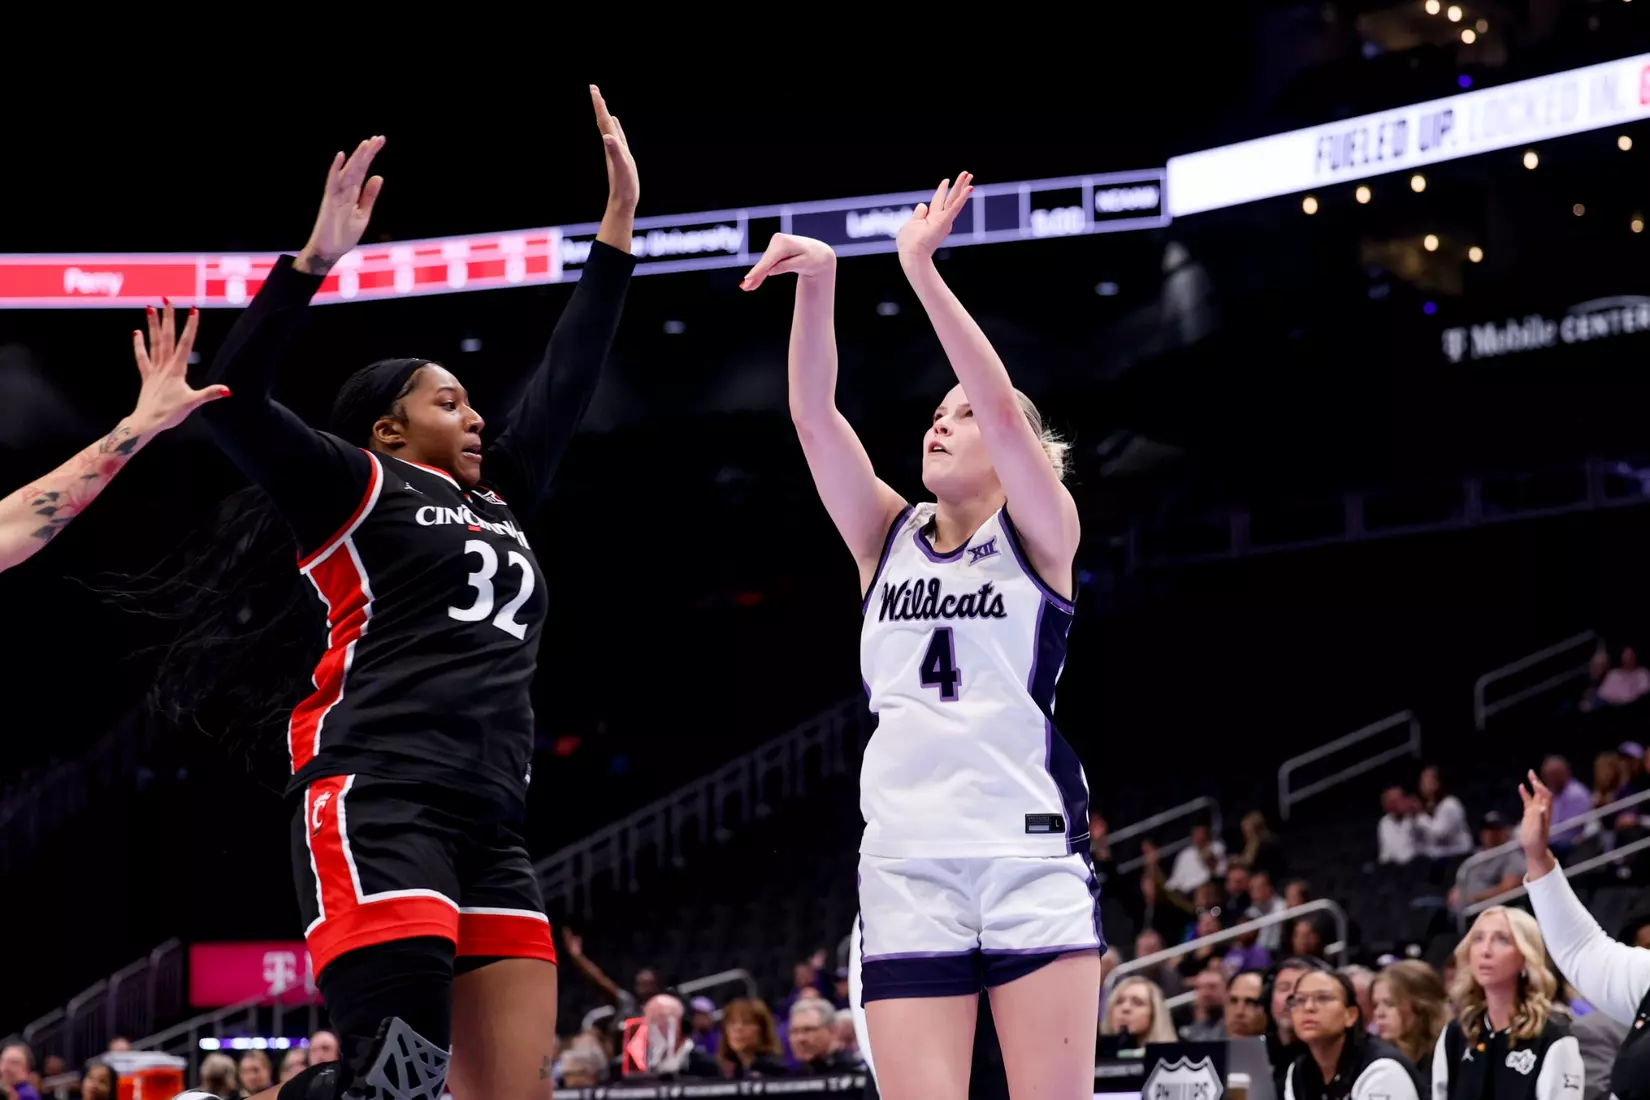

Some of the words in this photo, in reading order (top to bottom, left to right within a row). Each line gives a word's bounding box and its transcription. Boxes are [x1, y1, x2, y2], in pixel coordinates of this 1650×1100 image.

[1314, 118, 1408, 174] FUELED
[646, 224, 743, 257] University
[63, 267, 124, 297] Perry
[1471, 313, 1558, 360] Mobile
[447, 539, 535, 641] 32
[878, 577, 1007, 622] Wildcats
[919, 626, 962, 702] 4
